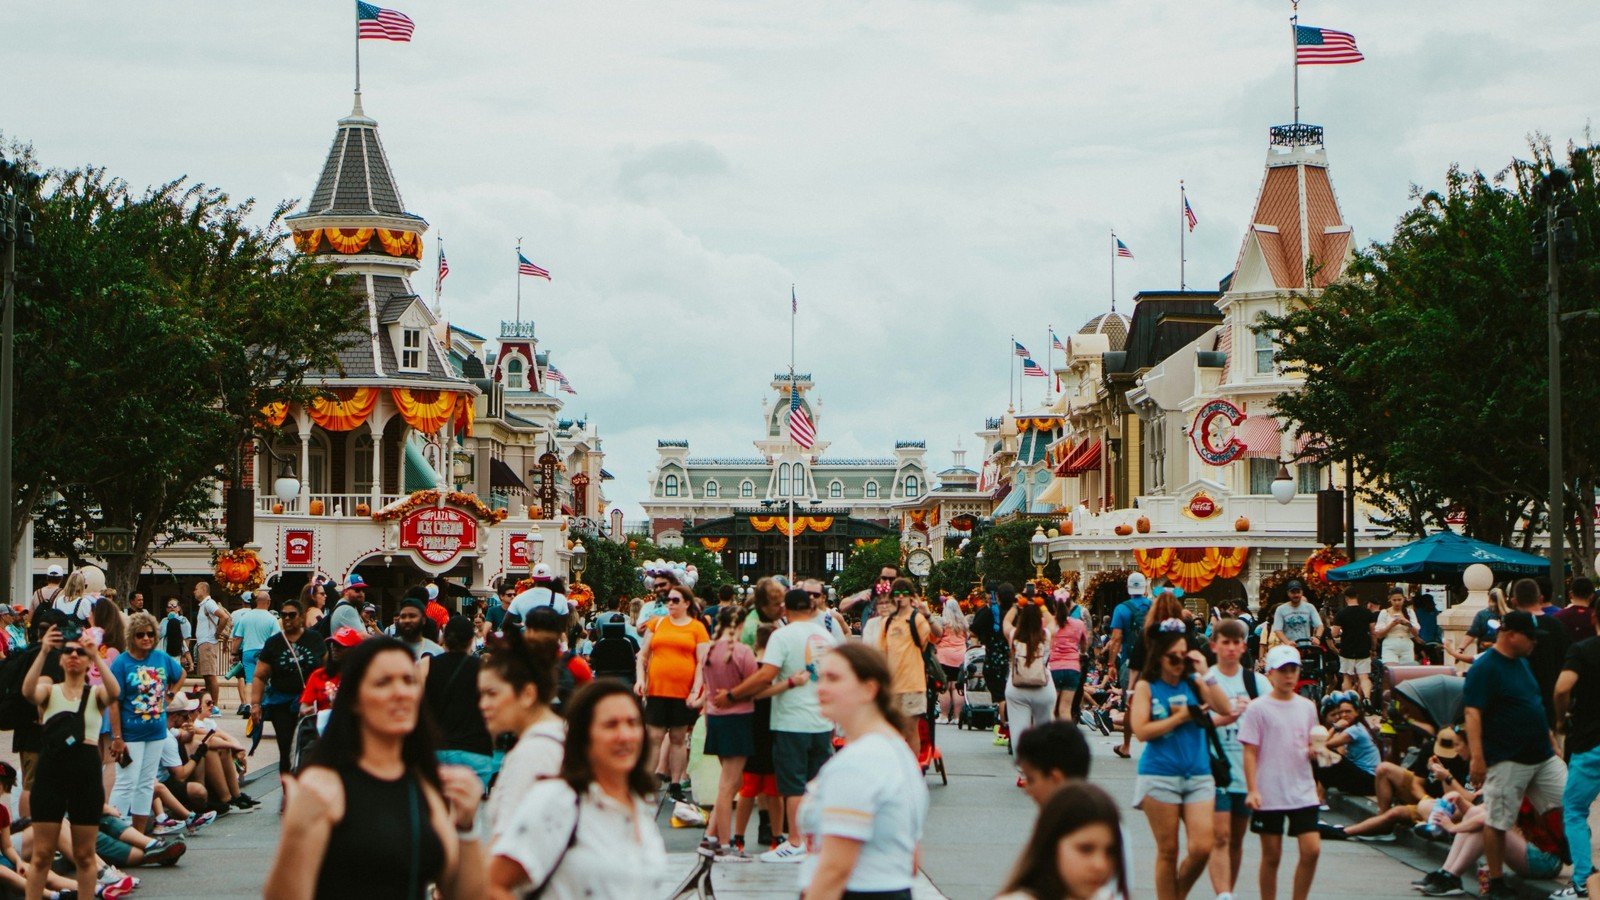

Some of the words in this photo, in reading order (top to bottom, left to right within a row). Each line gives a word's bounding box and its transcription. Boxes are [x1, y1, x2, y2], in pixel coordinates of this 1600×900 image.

[1201, 447, 1237, 462] CORNER
[430, 510, 449, 520] PLAZA
[416, 521, 433, 535] ICE
[433, 521, 464, 536] CREAM
[423, 536, 461, 550] PARLOR
